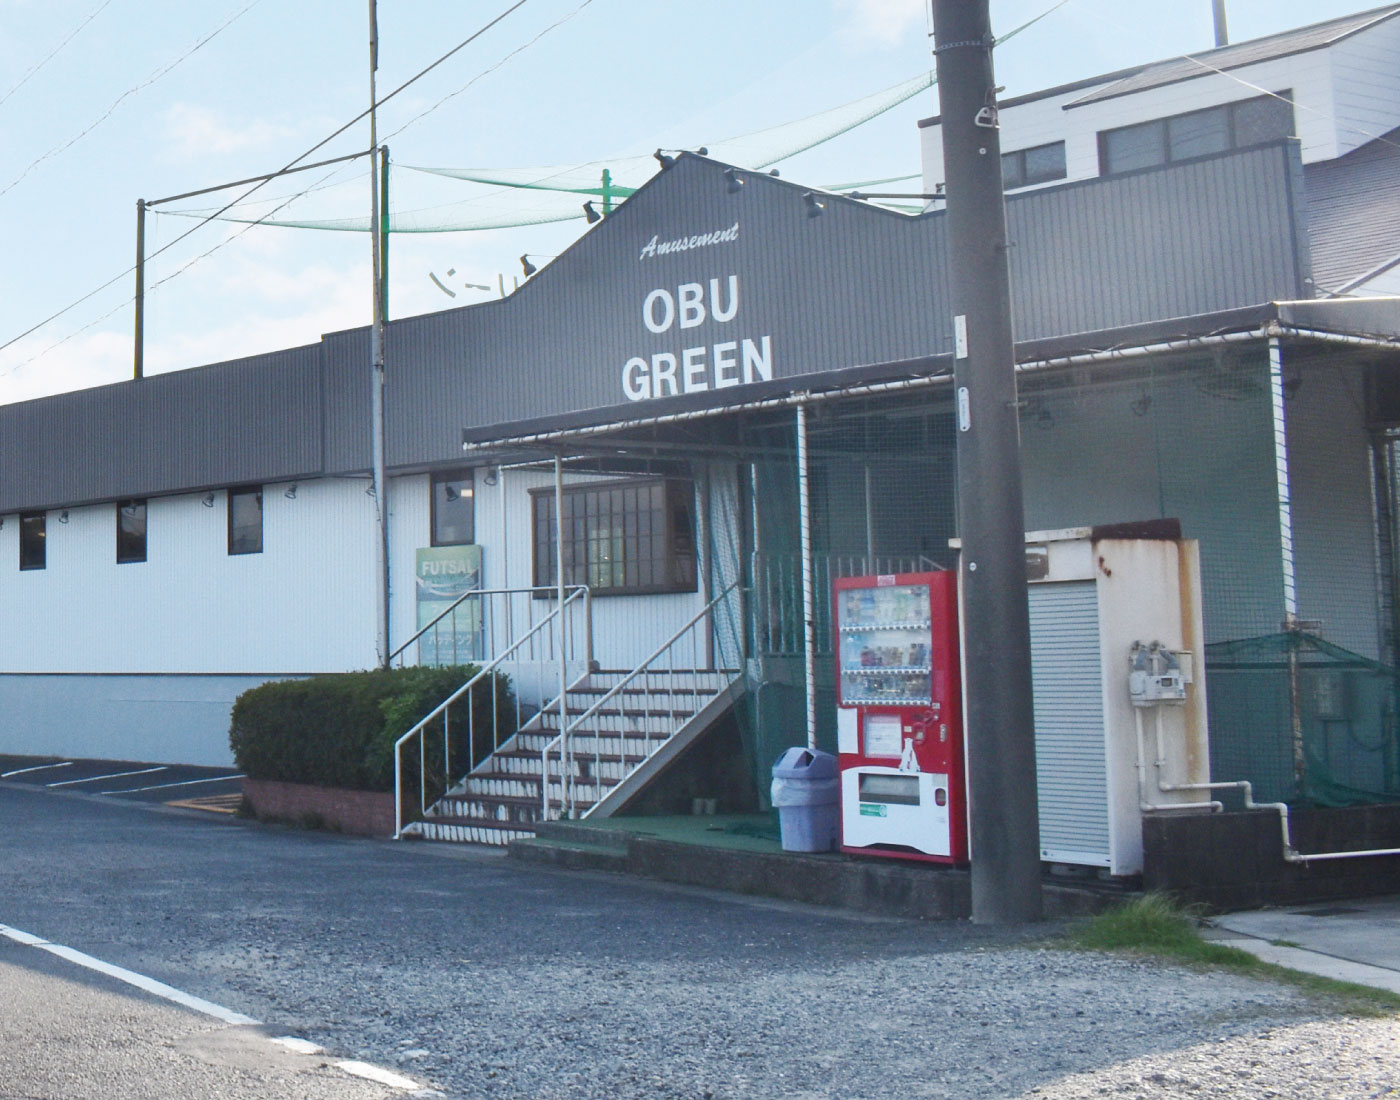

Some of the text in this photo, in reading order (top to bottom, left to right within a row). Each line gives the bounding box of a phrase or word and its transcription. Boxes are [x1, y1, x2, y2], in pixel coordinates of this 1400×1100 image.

[639, 222, 739, 260] Amusement
[643, 275, 738, 333] OBU
[622, 336, 773, 401] GREEN
[422, 559, 472, 576] FUTSAL
